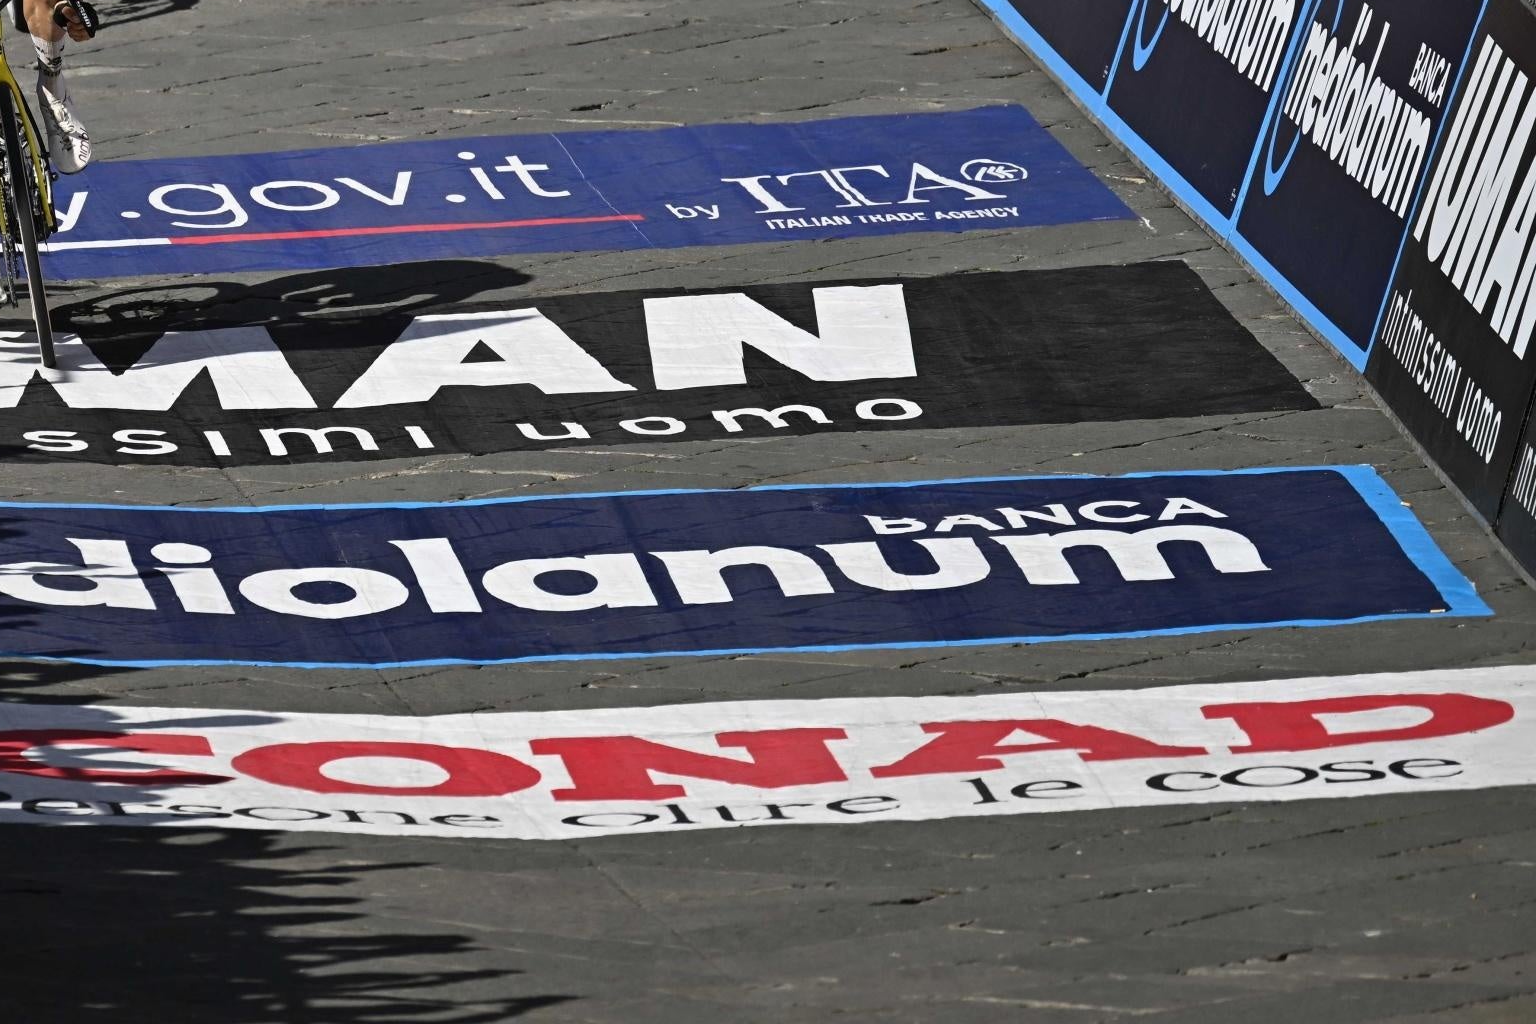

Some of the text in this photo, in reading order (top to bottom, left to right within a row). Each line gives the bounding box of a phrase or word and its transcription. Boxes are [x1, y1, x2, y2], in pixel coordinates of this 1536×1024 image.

[1408, 41, 1452, 110] BANCA
[1283, 1, 1432, 220] mediolanum
[667, 200, 722, 222] by
[721, 162, 1007, 215] ITA
[765, 205, 1020, 231] ITALIAN TRADE AGENCY
[1381, 289, 1502, 465] intimissimi uomo
[515, 396, 924, 442] uomo
[868, 496, 1228, 536] BANCA
[561, 796, 902, 829] oltre
[972, 777, 1083, 806] le
[1147, 755, 1465, 794] cose
